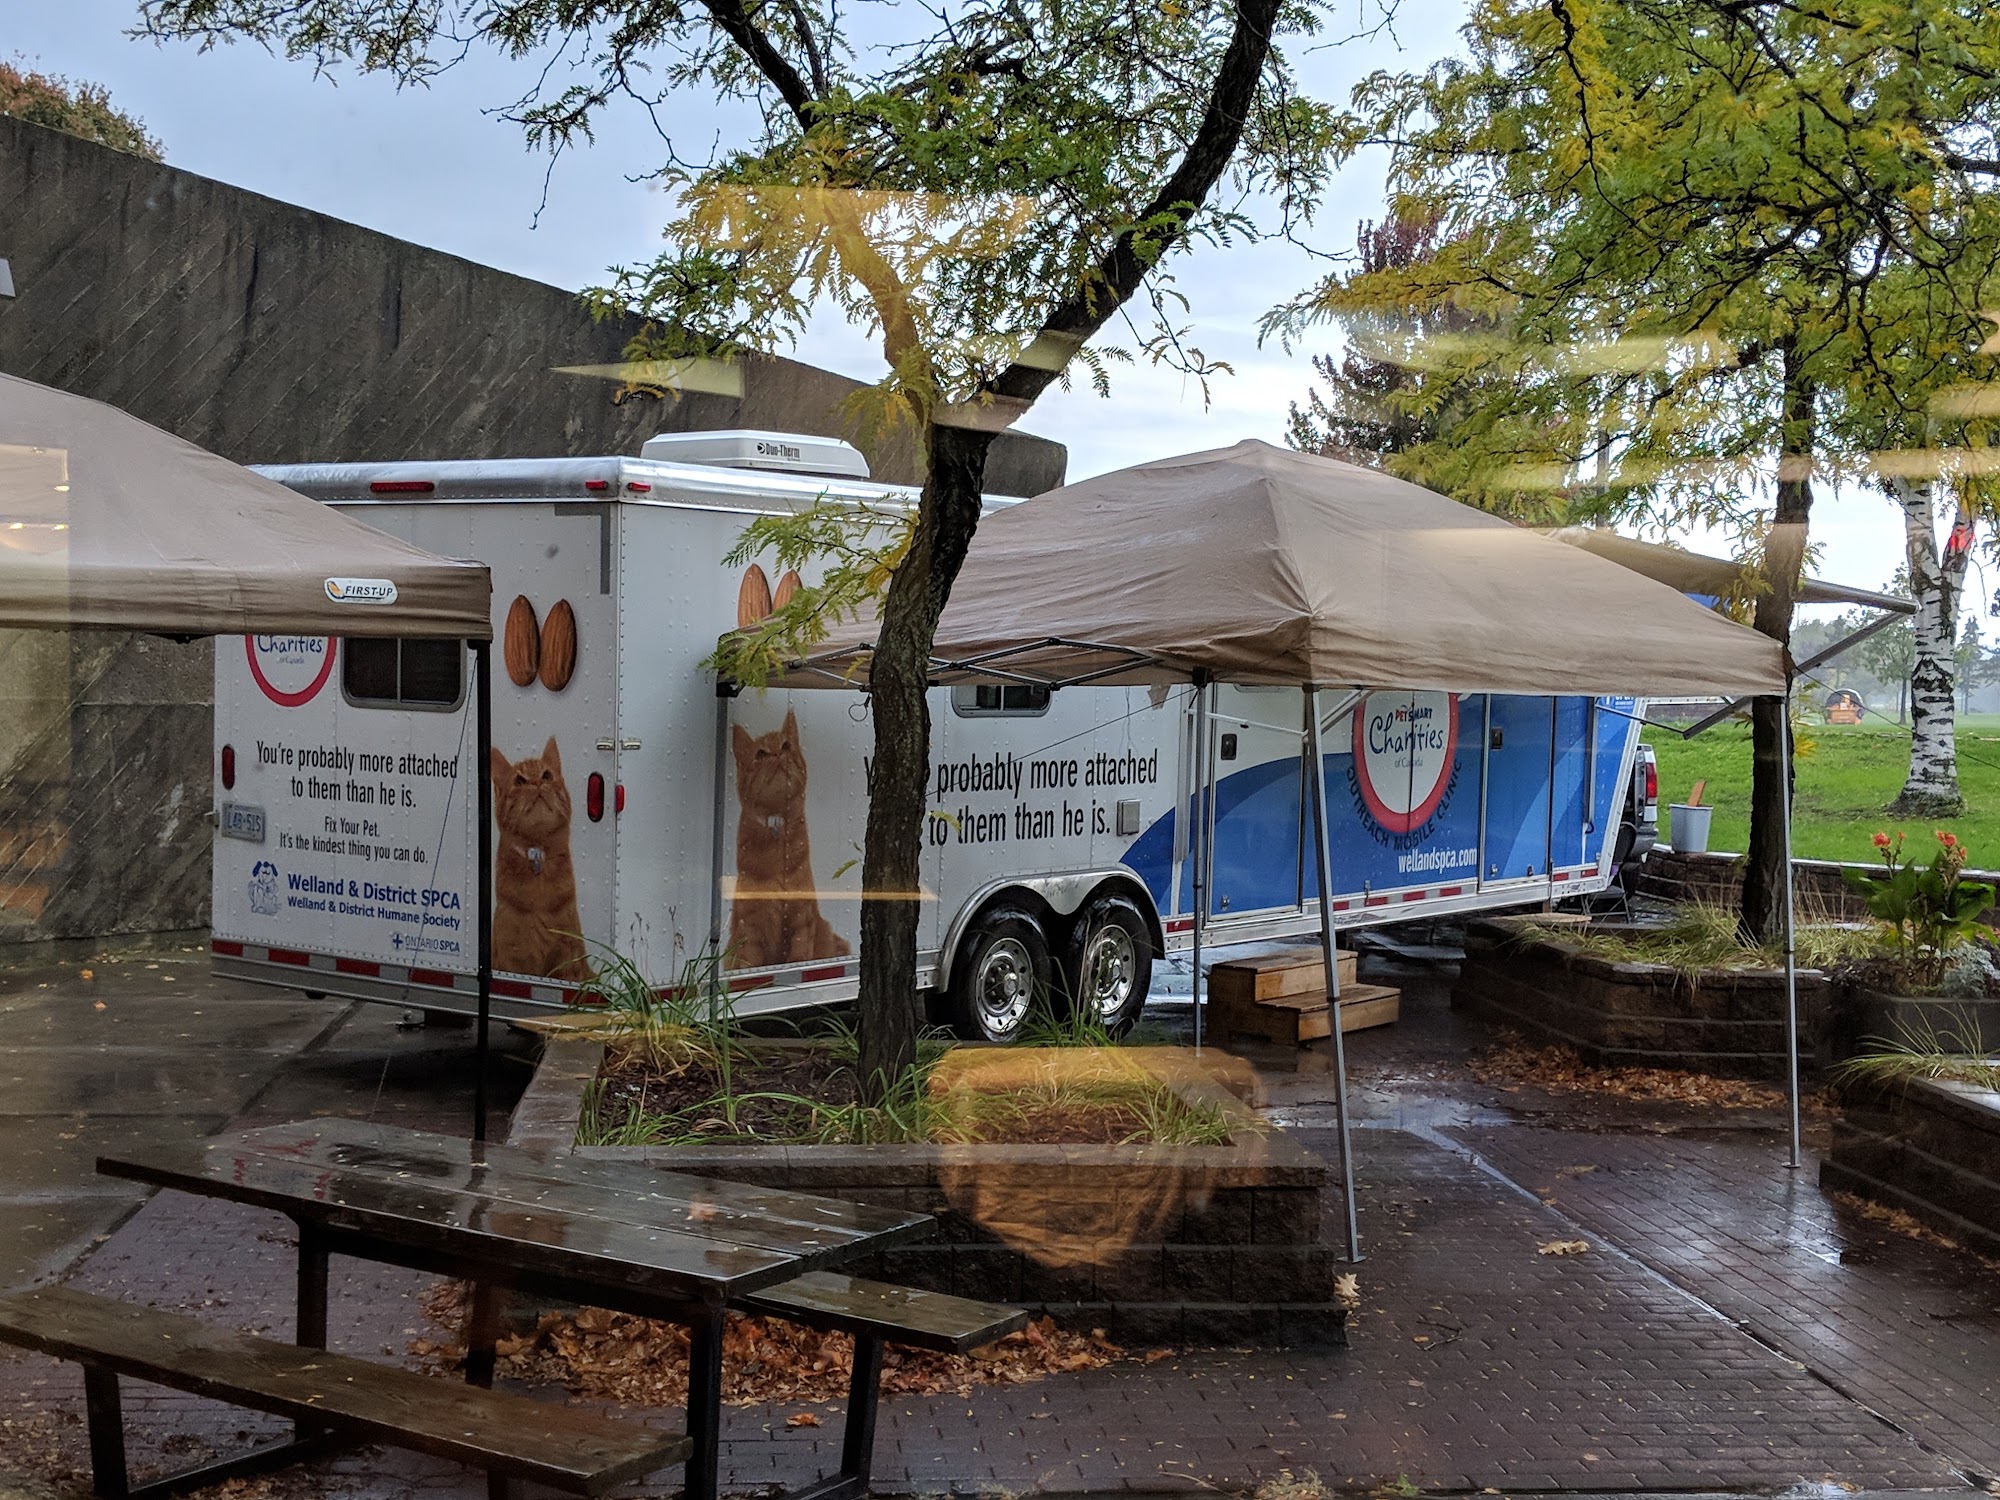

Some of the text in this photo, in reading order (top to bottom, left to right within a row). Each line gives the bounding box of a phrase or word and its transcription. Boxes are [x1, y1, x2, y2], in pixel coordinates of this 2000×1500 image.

[766, 443, 800, 458] Duo-Therm
[345, 585, 393, 597] FIRST-UP
[257, 634, 323, 653] Charities
[1369, 712, 1444, 754] Charities
[257, 741, 457, 779] You're probably more attached
[937, 748, 1158, 803] probably more attached
[291, 776, 416, 808] to them than he is.
[1436, 759, 1462, 820] CLINIC
[929, 800, 1110, 846] to them than he is.
[1346, 766, 1390, 848] OUTREACH
[324, 815, 380, 837] Fix Your Pet.
[1394, 820, 1436, 851] MOBILE
[280, 832, 428, 864] It's the kindest thing you can do.
[1398, 847, 1477, 874] wellandspca.com
[287, 873, 460, 910] Welland & District SPCA
[287, 895, 460, 931] Welland & District Humane Society
